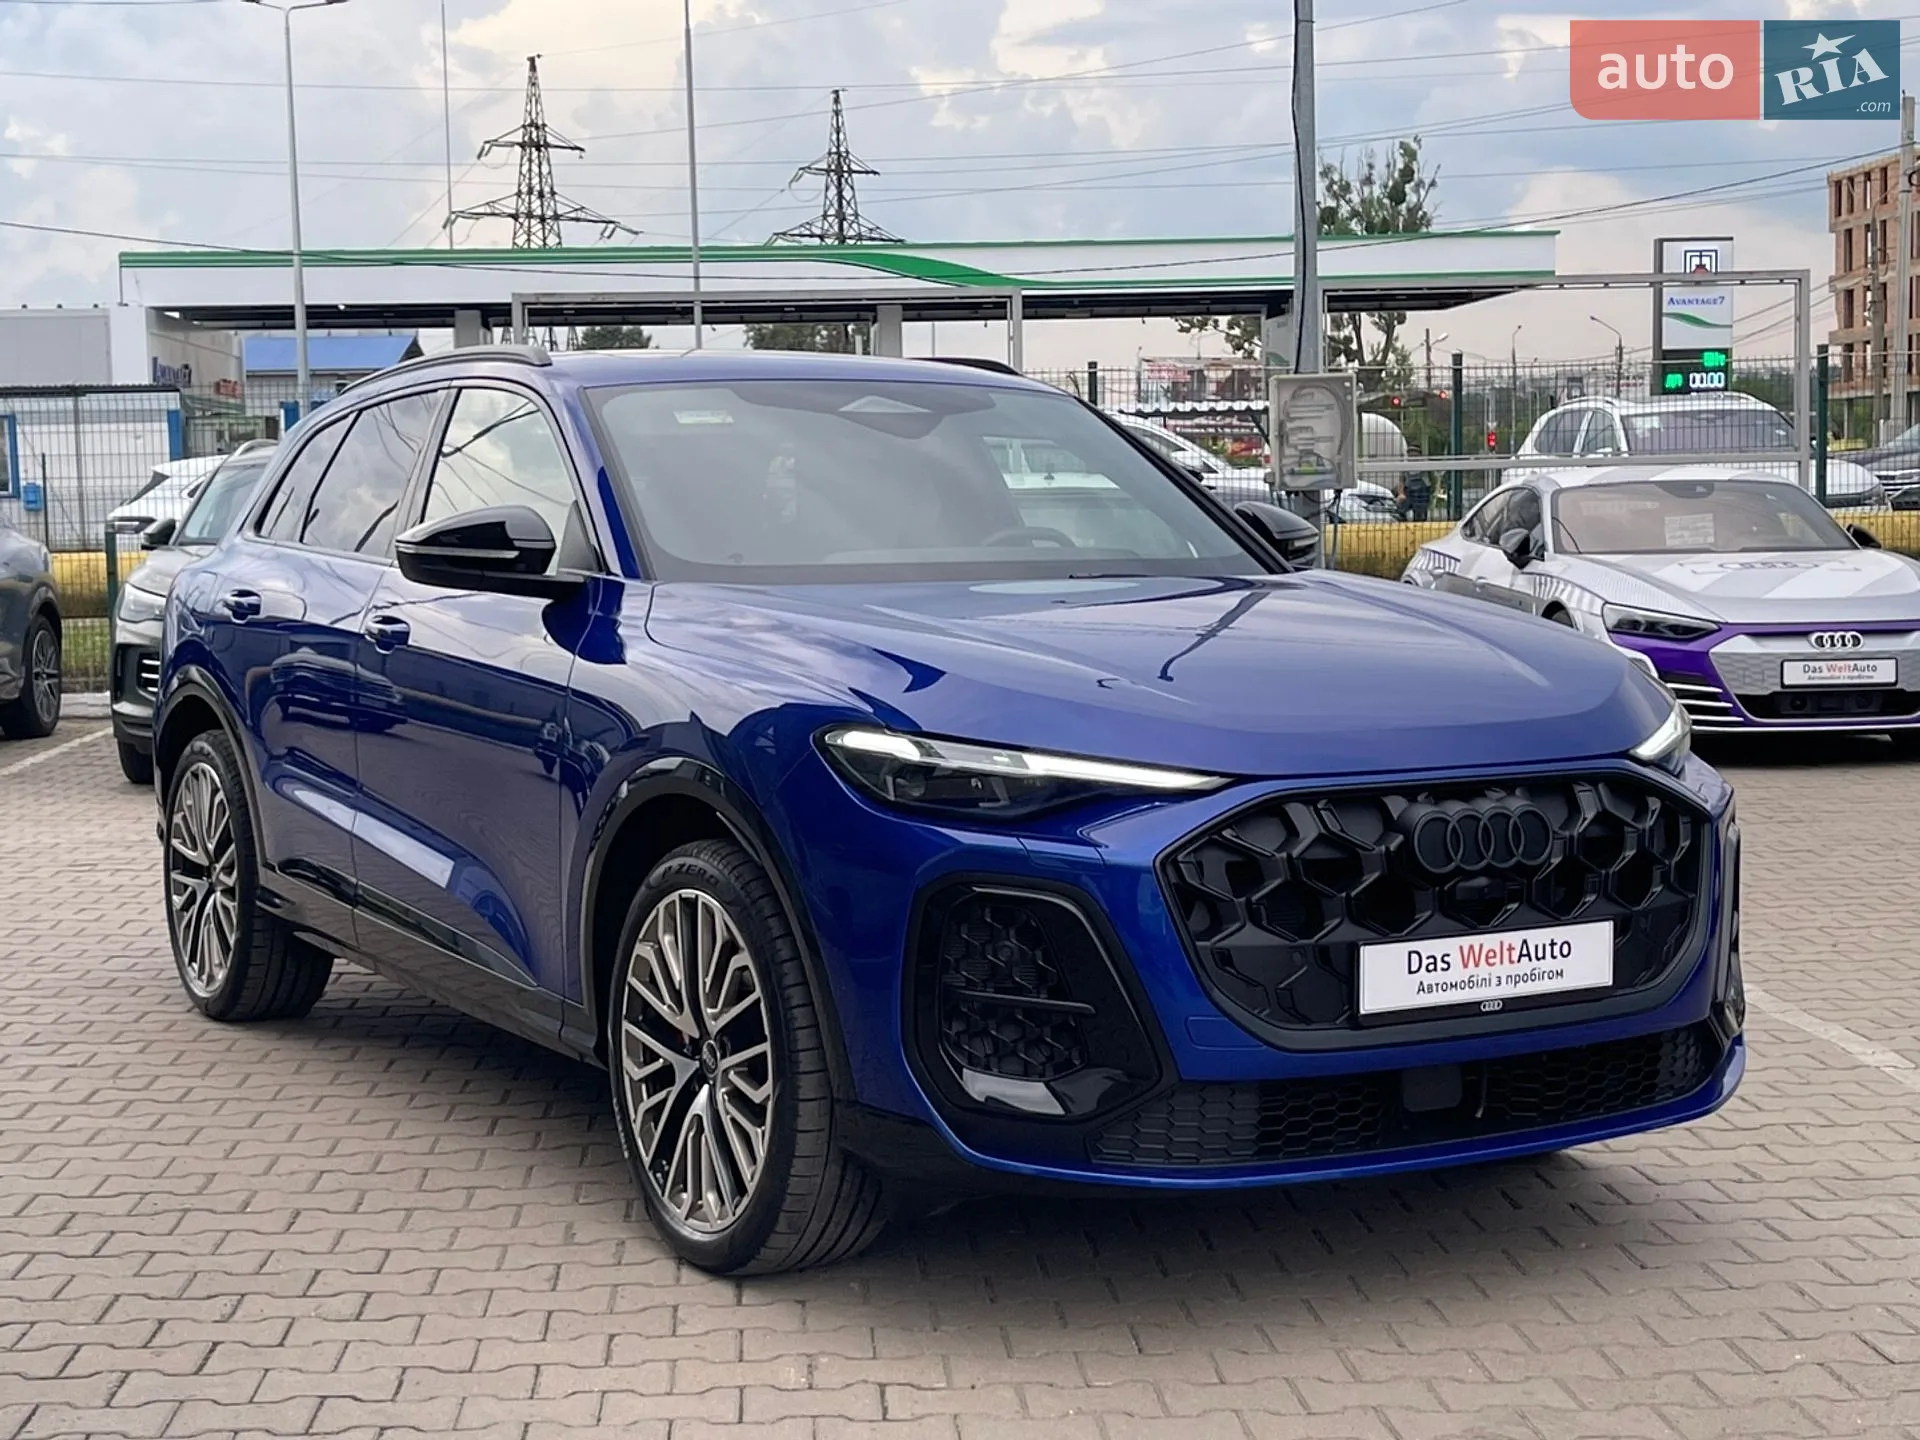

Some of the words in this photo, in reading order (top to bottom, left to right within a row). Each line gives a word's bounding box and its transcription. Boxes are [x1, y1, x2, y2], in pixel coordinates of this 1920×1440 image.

[1803, 663, 1823, 674] Das
[1826, 662, 1878, 674] WeltAuto
[1407, 949, 1451, 975] Das
[1459, 938, 1573, 971] WeltAuto
[1416, 973, 1493, 996] Автомобілі
[1495, 973, 1503, 988] з
[1505, 967, 1565, 989] пробігом
